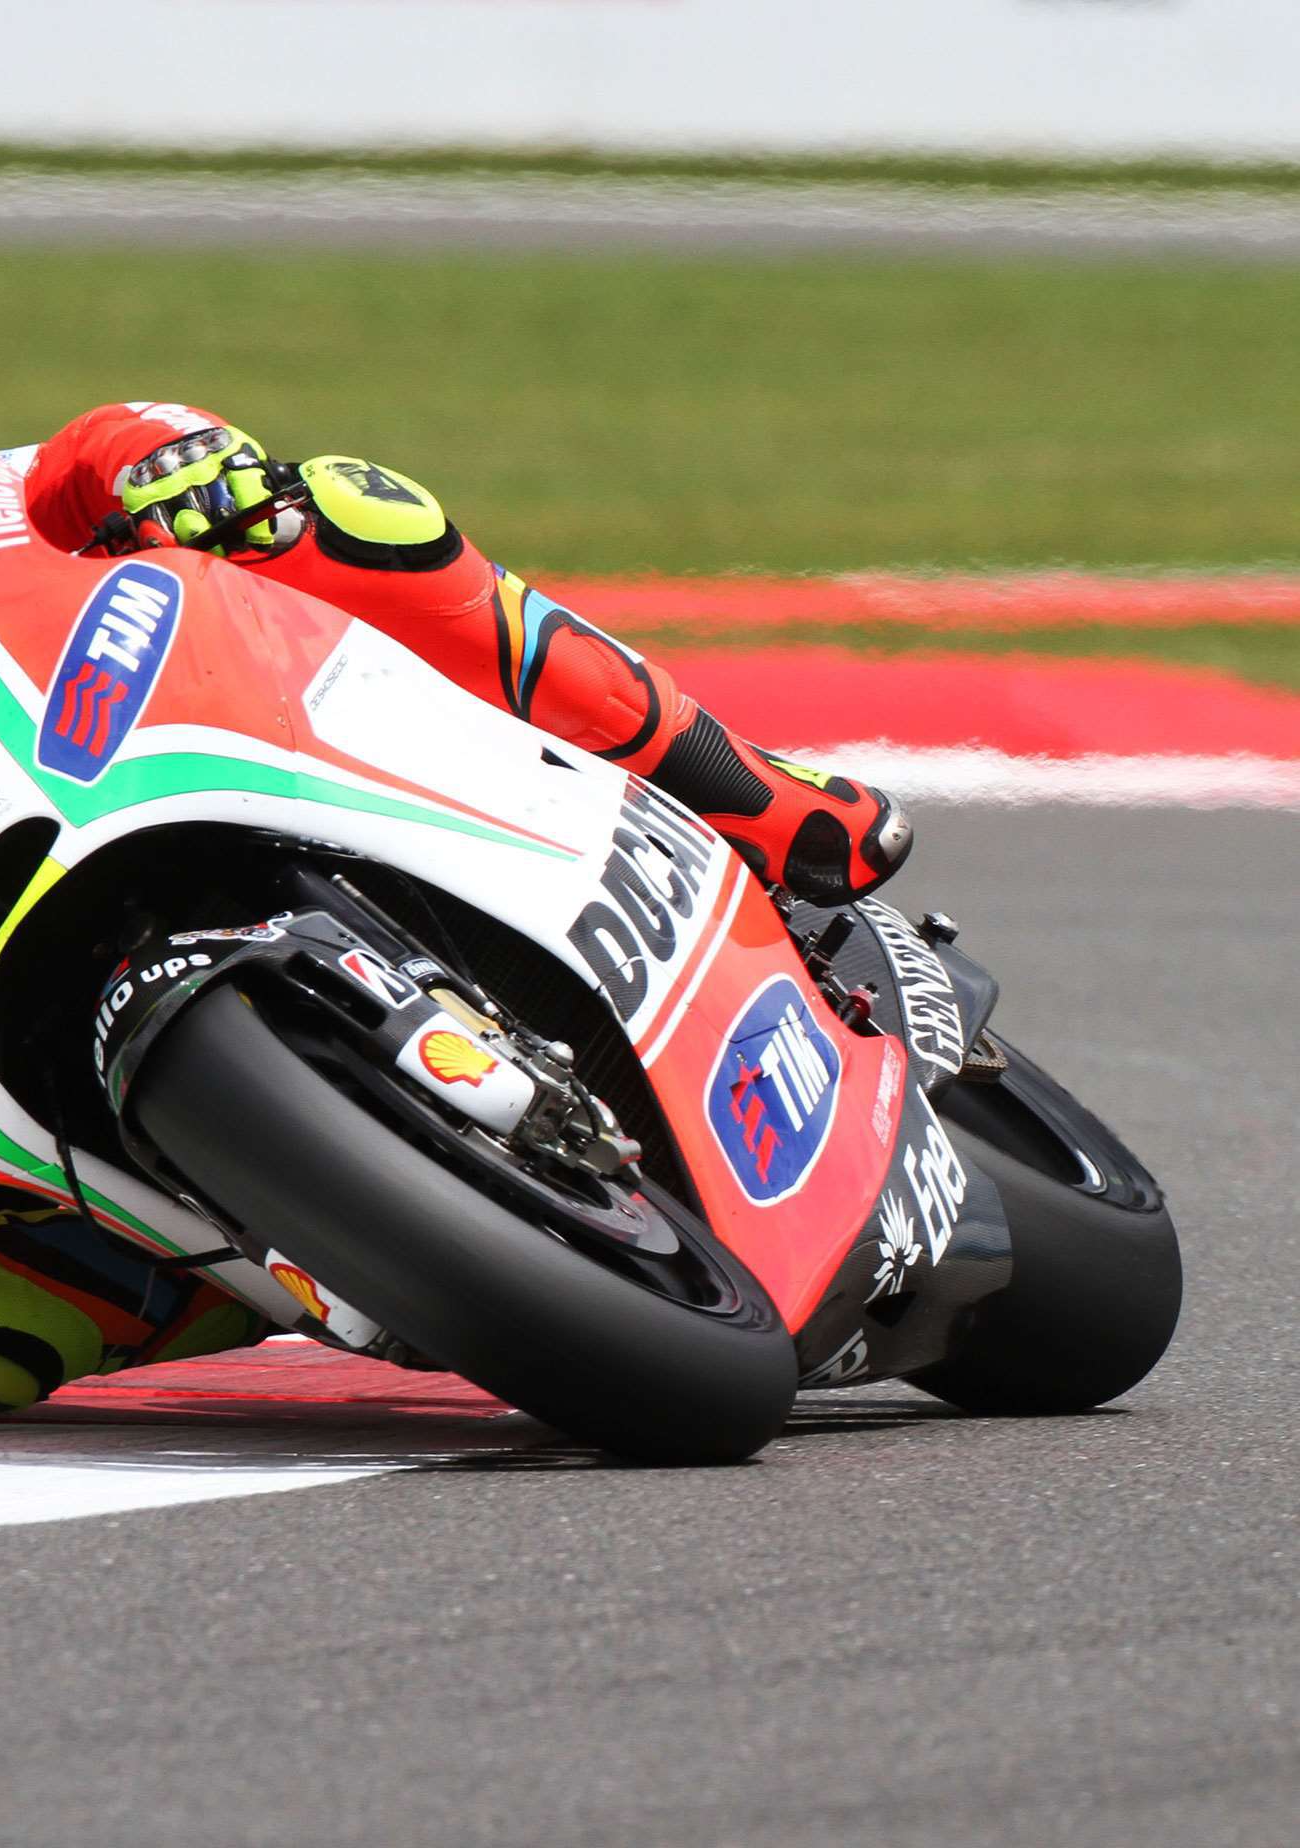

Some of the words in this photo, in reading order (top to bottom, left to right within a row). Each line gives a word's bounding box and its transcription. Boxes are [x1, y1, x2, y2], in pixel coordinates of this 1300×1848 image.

[86, 577, 170, 673] TIM
[565, 772, 717, 1024] DUCATI
[139, 952, 213, 985] ups
[758, 1003, 831, 1133] TIM
[904, 1083, 967, 1267] Enel
